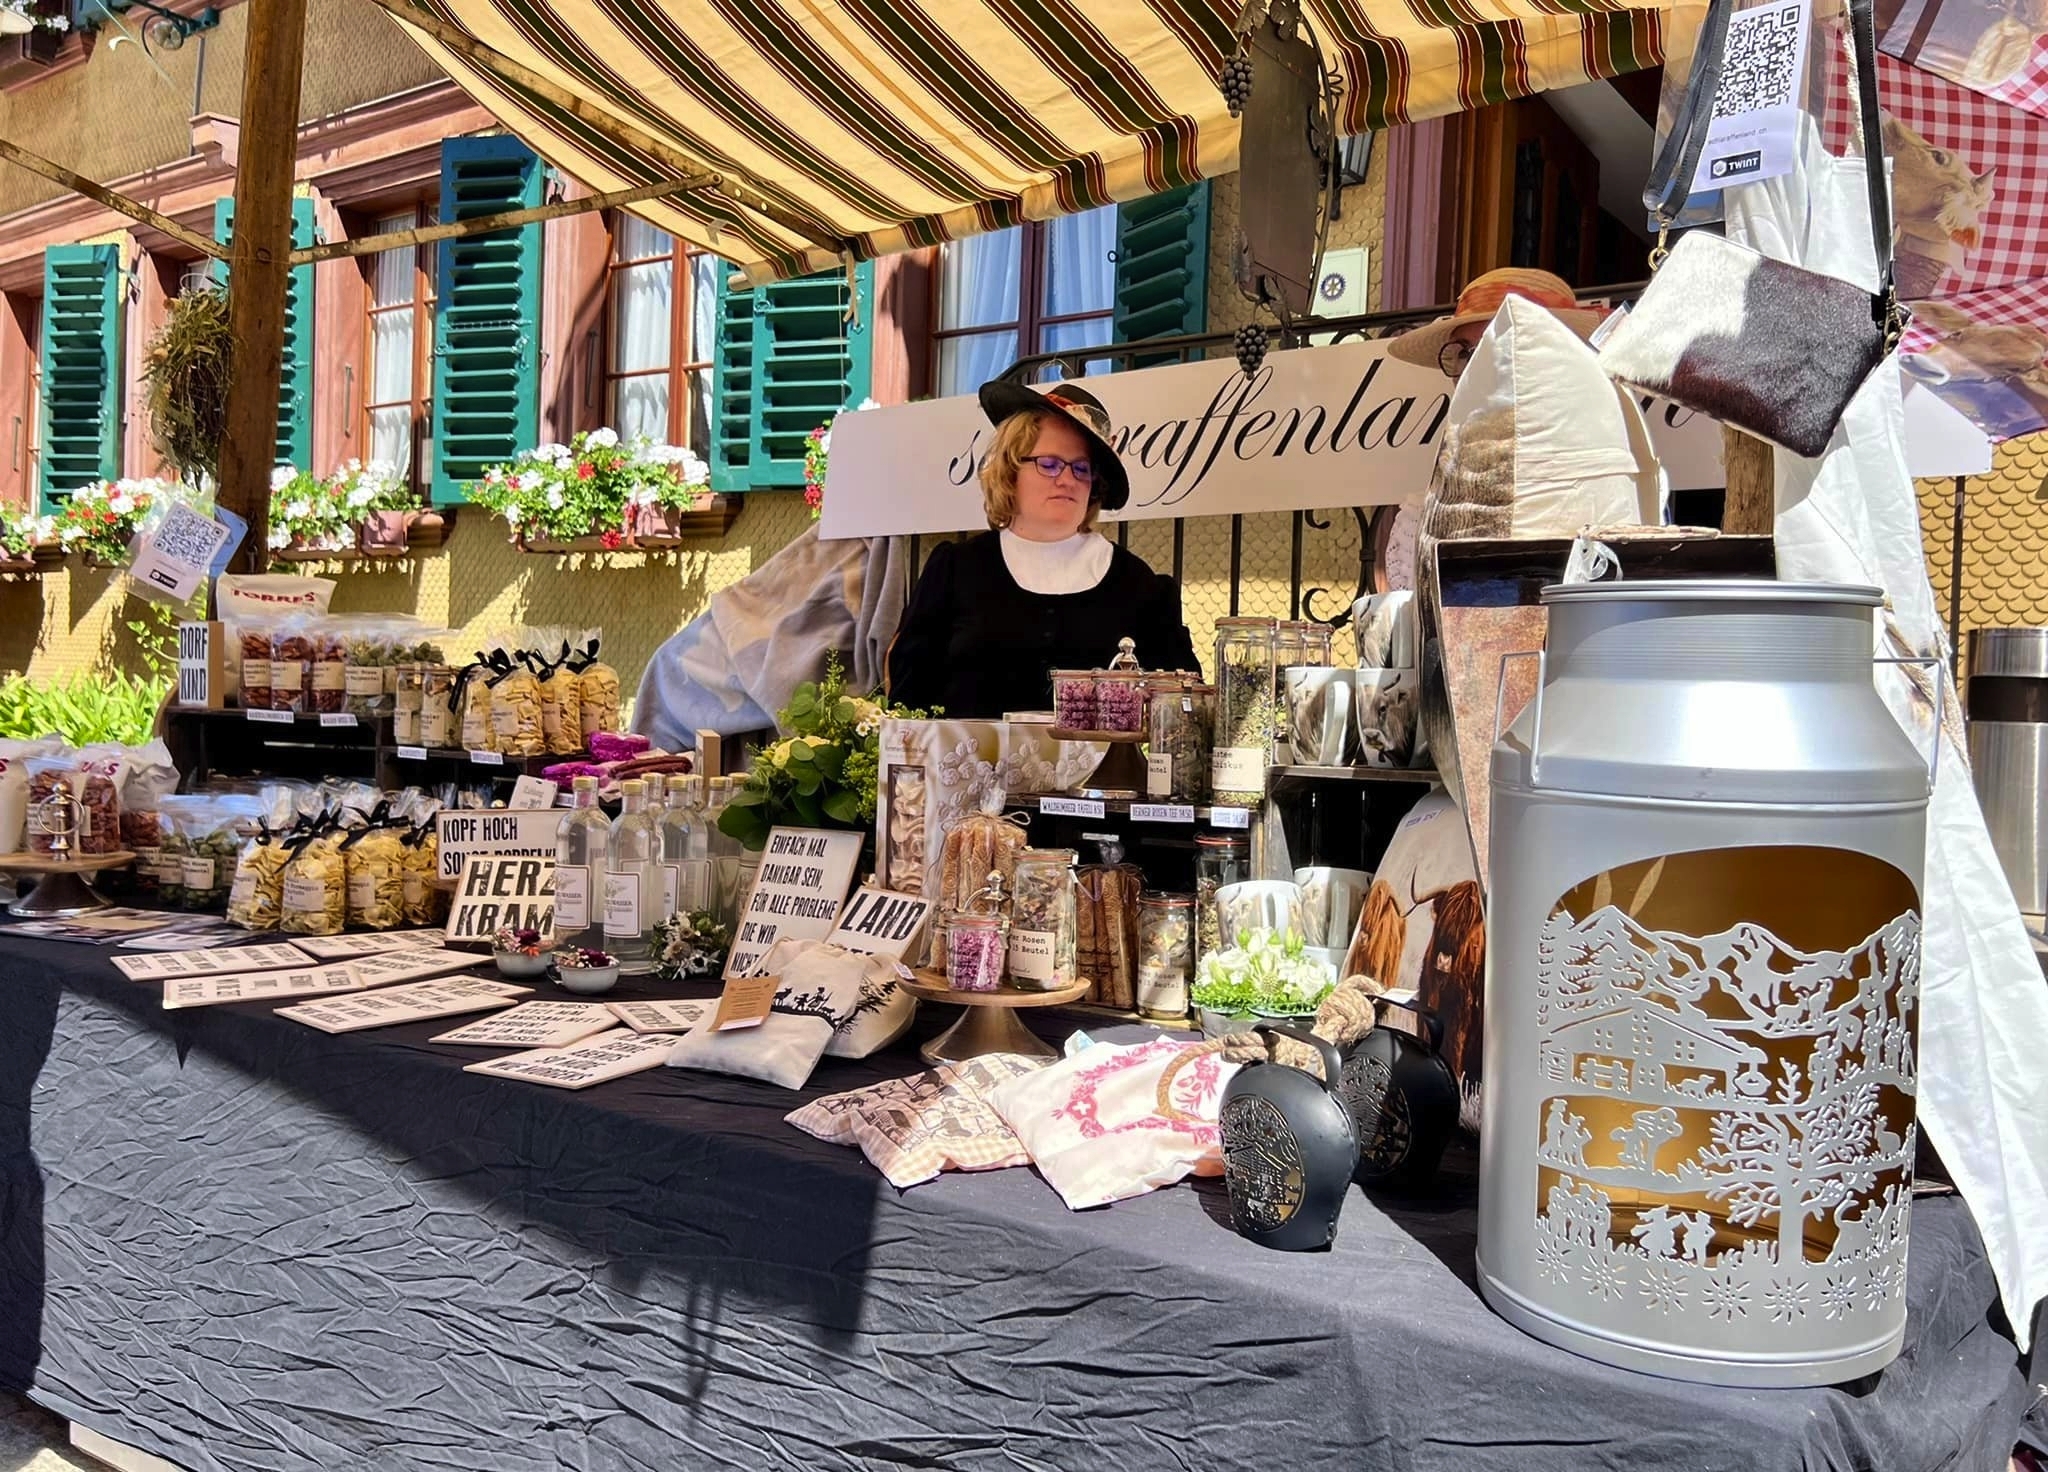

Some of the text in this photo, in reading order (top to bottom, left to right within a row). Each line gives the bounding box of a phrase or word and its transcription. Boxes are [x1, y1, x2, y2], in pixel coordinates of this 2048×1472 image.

[1728, 157, 1759, 171] TWINT
[179, 626, 208, 660] DORF
[180, 668, 207, 701] KIND
[443, 816, 518, 843] KOPF HOCH
[769, 834, 828, 857] EINFACH MAL
[464, 860, 555, 896] HERZ
[760, 863, 824, 892] DANKBAR SEIN,
[750, 888, 839, 920] FÜR ALLE PROBLEME
[839, 892, 926, 941] LAND
[454, 904, 555, 937] KRAM
[740, 921, 777, 945] DIE WIR
[1022, 935, 1046, 944] Rosen
[1022, 945, 1049, 955] Beutel
[731, 951, 760, 973] NICHT
